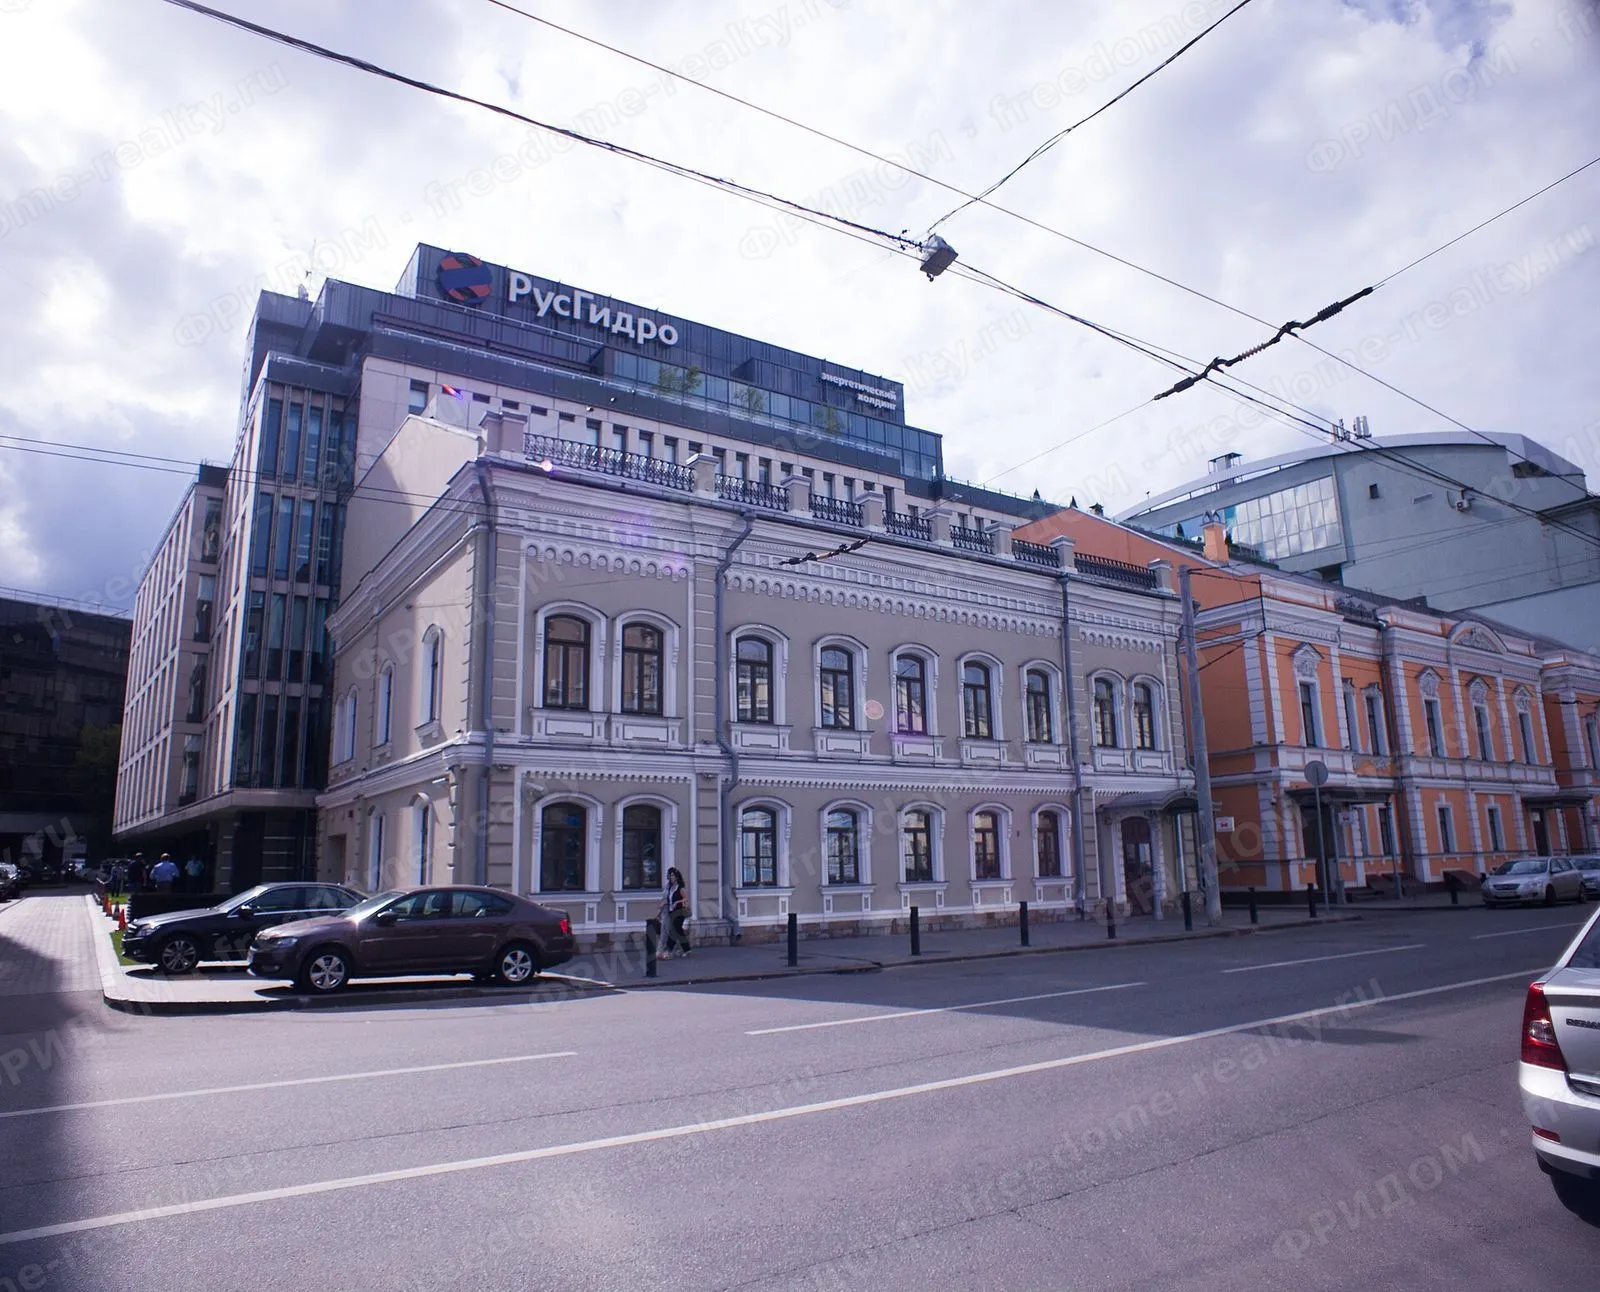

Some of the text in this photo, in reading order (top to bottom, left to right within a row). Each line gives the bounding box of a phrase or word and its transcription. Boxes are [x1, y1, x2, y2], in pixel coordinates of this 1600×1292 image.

[508, 271, 679, 346] РусГидро
[821, 372, 897, 401] энергетический
[857, 393, 897, 410] холдинг
